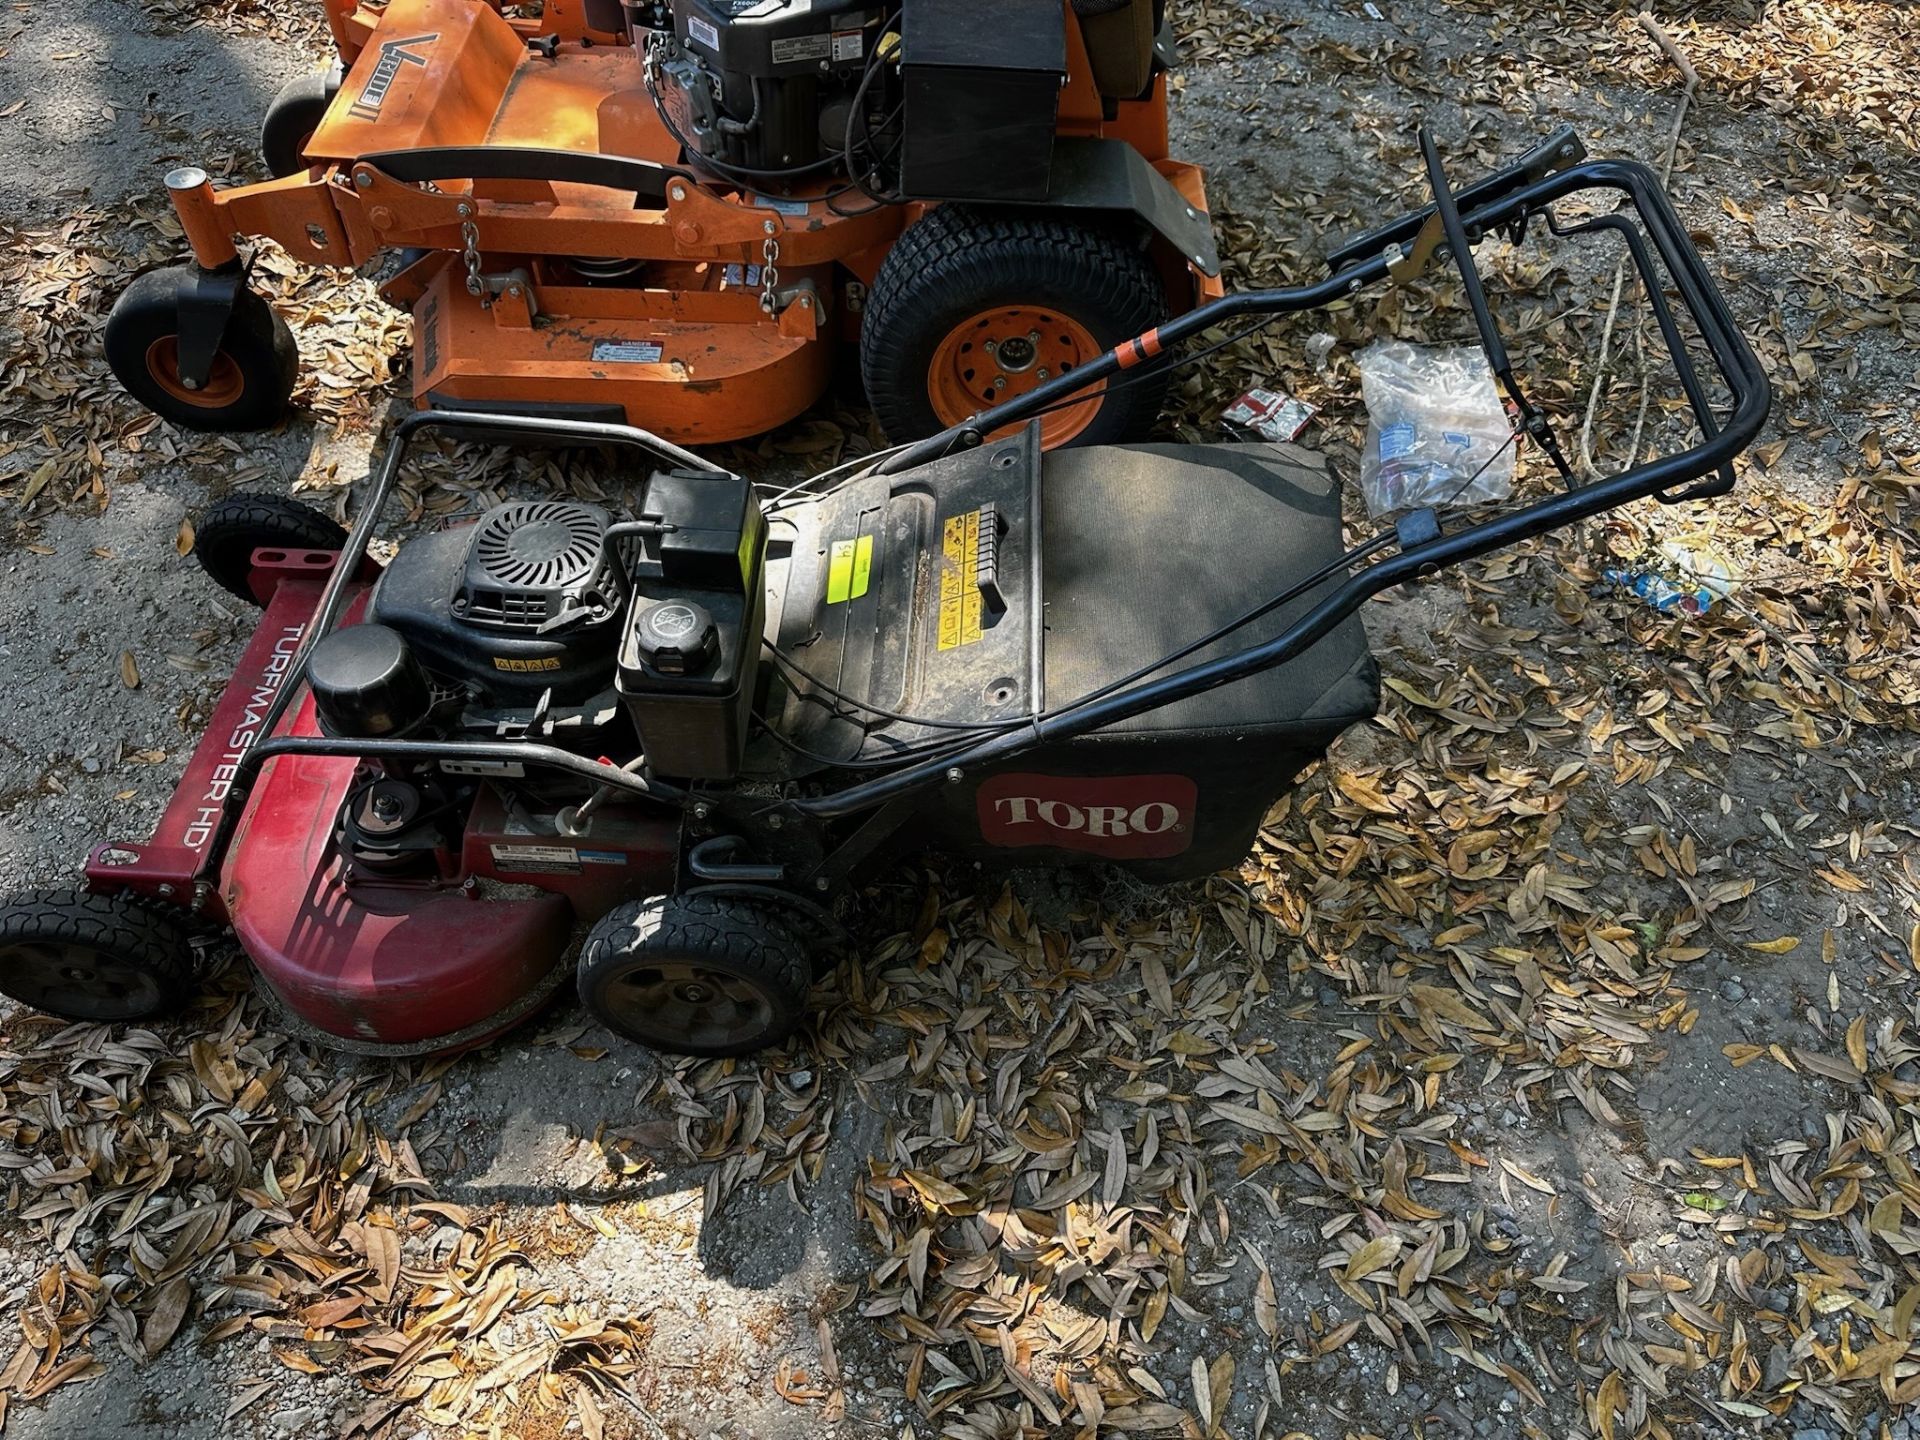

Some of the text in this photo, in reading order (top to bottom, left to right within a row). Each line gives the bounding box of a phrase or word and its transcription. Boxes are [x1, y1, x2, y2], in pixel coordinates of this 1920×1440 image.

[183, 622, 305, 848] TURFMASTER HD
[995, 797, 1179, 837] TORO
